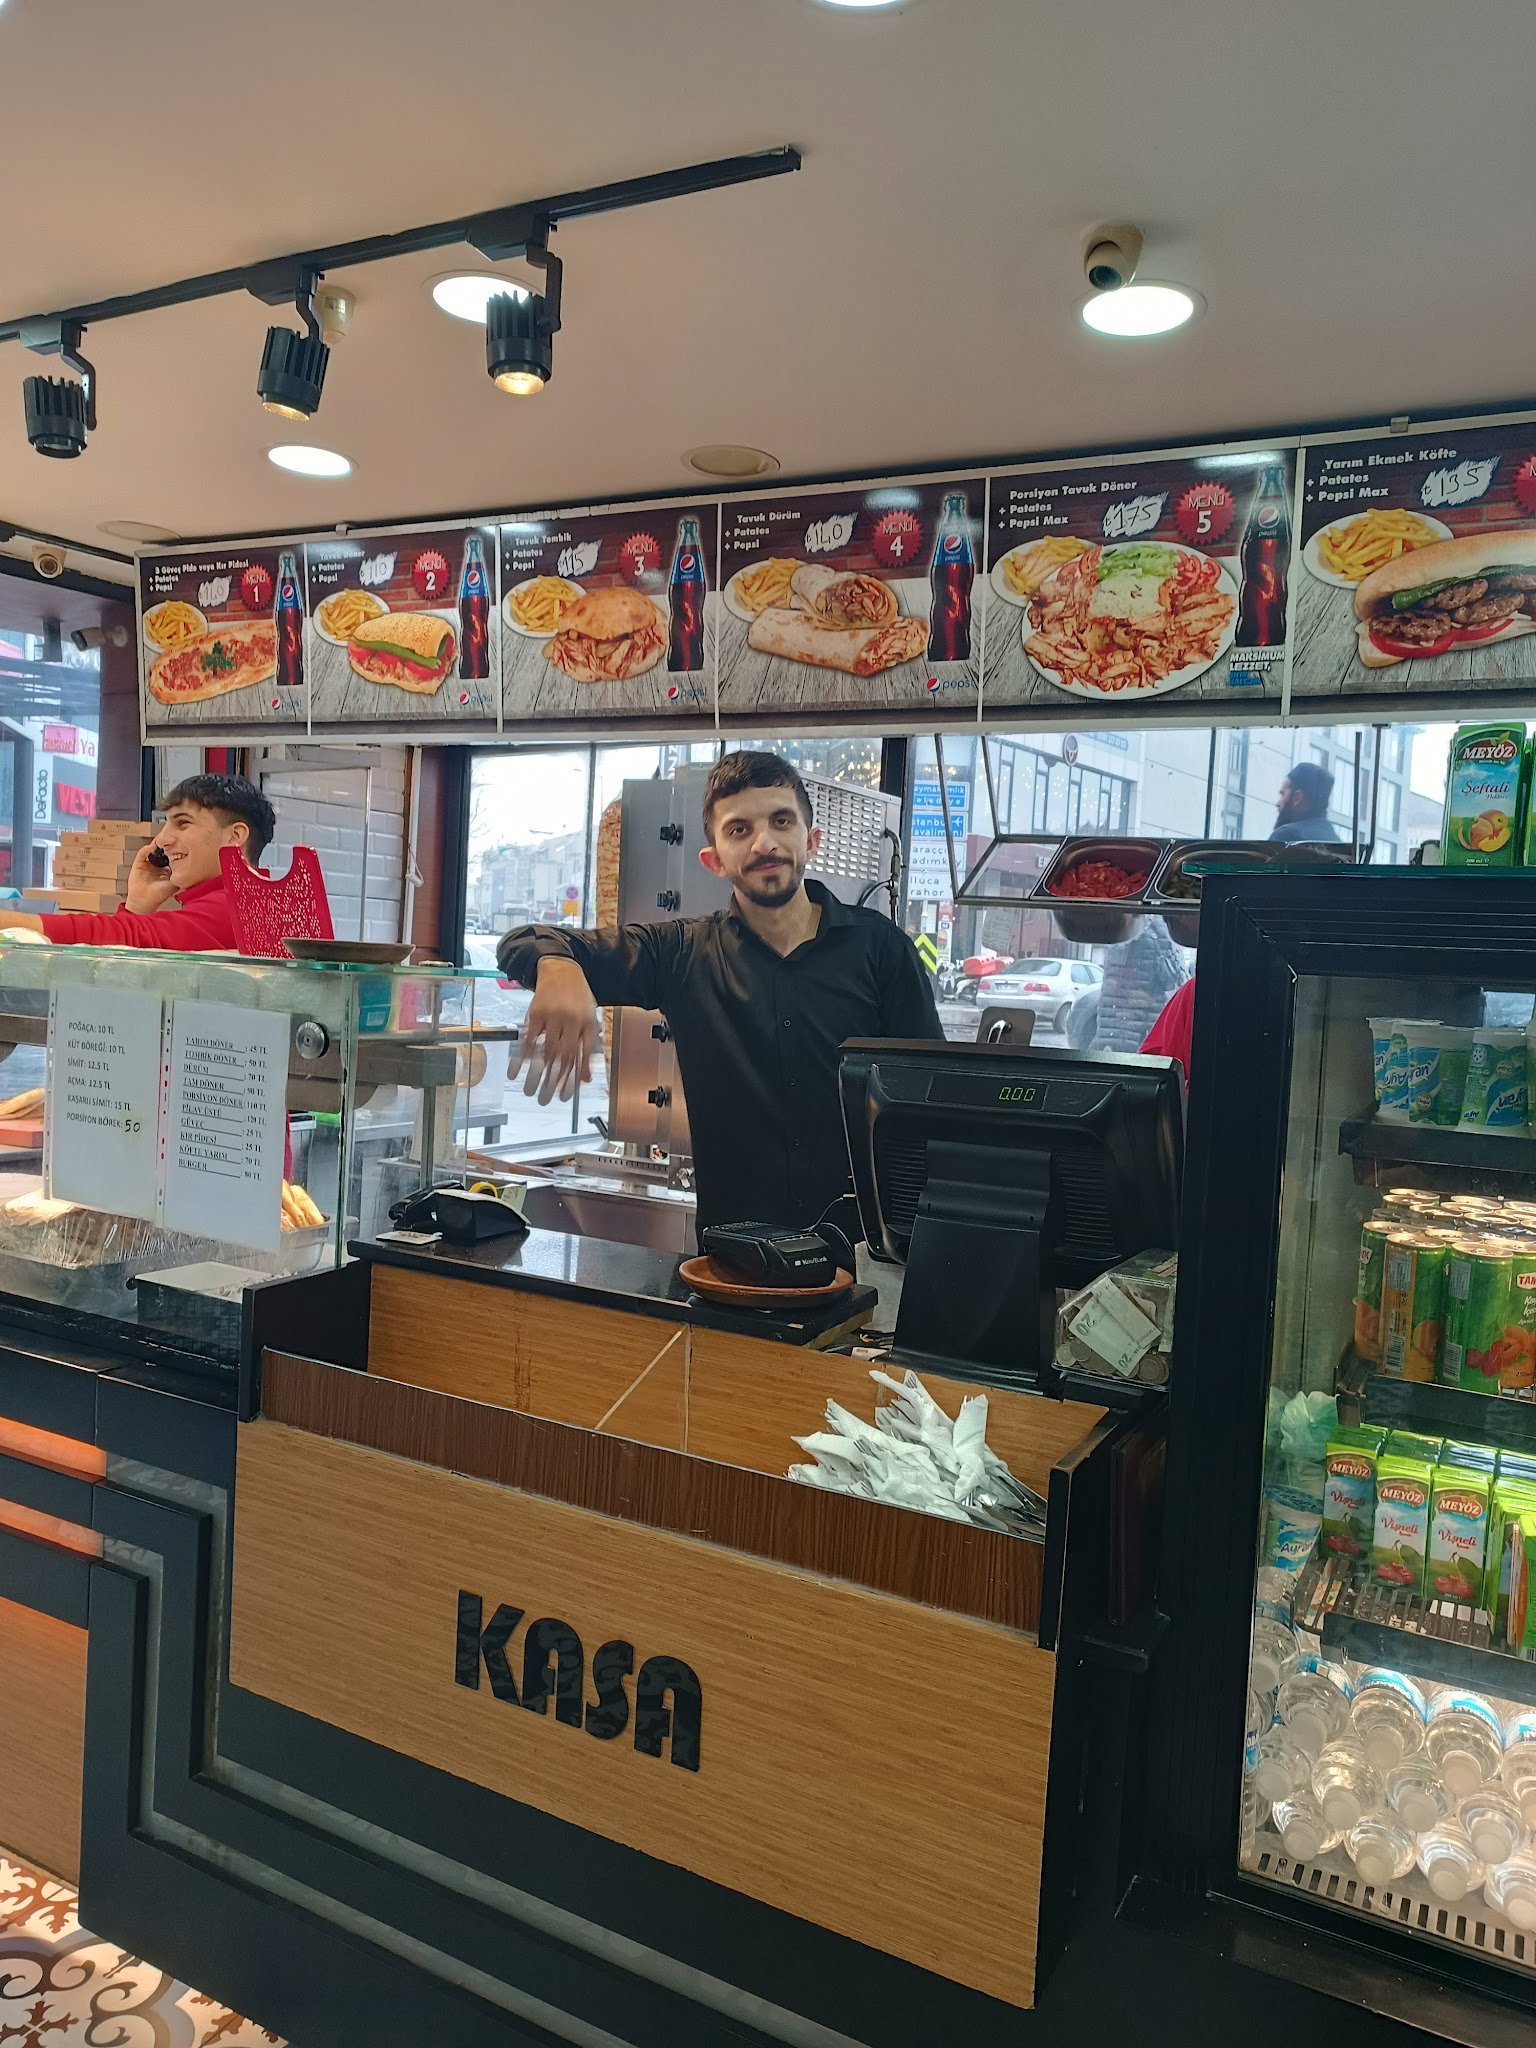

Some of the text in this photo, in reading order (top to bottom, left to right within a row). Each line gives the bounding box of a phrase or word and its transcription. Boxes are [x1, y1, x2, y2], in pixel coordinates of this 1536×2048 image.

[1325, 449, 1458, 471] Yarım Ekmek Köfte
[1319, 474, 1369, 486] Patates
[1010, 481, 1137, 501] Porsiyon Tavuk Döner
[1318, 490, 1353, 502] Pepsi
[1358, 487, 1389, 498] Max
[1010, 503, 1052, 514] Patates
[737, 510, 800, 524] Tavuk Dürüm
[1009, 518, 1040, 530] Pepsi
[1044, 515, 1068, 526] Max
[1196, 511, 1211, 533] 5
[734, 526, 770, 537] Patates
[515, 533, 572, 546] Tavuk Tombik
[734, 539, 760, 551] Pepsi
[890, 535, 903, 557] 4
[512, 549, 543, 558] Patates
[182, 563, 197, 573] Pide
[228, 559, 249, 569] Pidesi
[318, 563, 345, 572] Patates
[512, 560, 535, 572] Pepsi
[634, 556, 644, 576] 3
[155, 574, 179, 583] Patates
[318, 573, 338, 584] Pepsi
[425, 572, 436, 591] 2
[155, 582, 173, 593] Pepsi
[253, 586, 259, 603] 1
[1462, 743, 1515, 760] MEYÖZ
[35, 769, 48, 819] DeFacto
[1461, 780, 1510, 796] Şeftali
[913, 828, 963, 837] avalimnı
[912, 847, 947, 855] araççı
[912, 856, 962, 867] adımky
[910, 876, 940, 885] lluca
[910, 888, 944, 897] rahor
[98, 1025, 106, 1034] 10
[107, 1026, 115, 1035] TL
[109, 1045, 117, 1054] 10
[117, 1045, 126, 1055] TL
[210, 1039, 234, 1050] DÖNER
[259, 1046, 268, 1055] TL
[88, 1061, 101, 1070] 12.5
[103, 1062, 110, 1071] TL
[213, 1053, 237, 1065] DÖNER
[248, 1059, 257, 1067] 50
[259, 1060, 268, 1069] TL
[88, 1079, 103, 1089] 12.5
[104, 1081, 111, 1090] TL
[248, 1073, 256, 1081] 70
[258, 1074, 267, 1083] TL
[199, 1079, 225, 1091] DÖNER
[256, 1088, 265, 1097] TL
[998, 1086, 1036, 1101] 0.00
[114, 1101, 122, 1110] 15
[123, 1102, 131, 1111] TL
[182, 1090, 218, 1103] PORSİYON
[247, 1101, 258, 1110] 110
[259, 1103, 268, 1112] TL
[66, 1112, 97, 1125] PORSİYON
[124, 1119, 141, 1133] 50
[258, 1117, 267, 1126] TL
[255, 1130, 263, 1140] TL
[245, 1143, 253, 1151] 25
[255, 1144, 263, 1154] TL
[245, 1157, 253, 1165] 70
[254, 1158, 263, 1167] TL
[178, 1158, 207, 1170] BURGER
[253, 1172, 262, 1181] TL
[1075, 1312, 1096, 1337] 20
[1331, 1463, 1370, 1478] MEYÖZ
[1382, 1488, 1422, 1506] MEYÖZ
[1440, 1500, 1480, 1515] MEYÖZ
[1381, 1517, 1419, 1534] Vişneli
[1438, 1528, 1477, 1547] Vişneli
[455, 1589, 703, 1773] KASA
